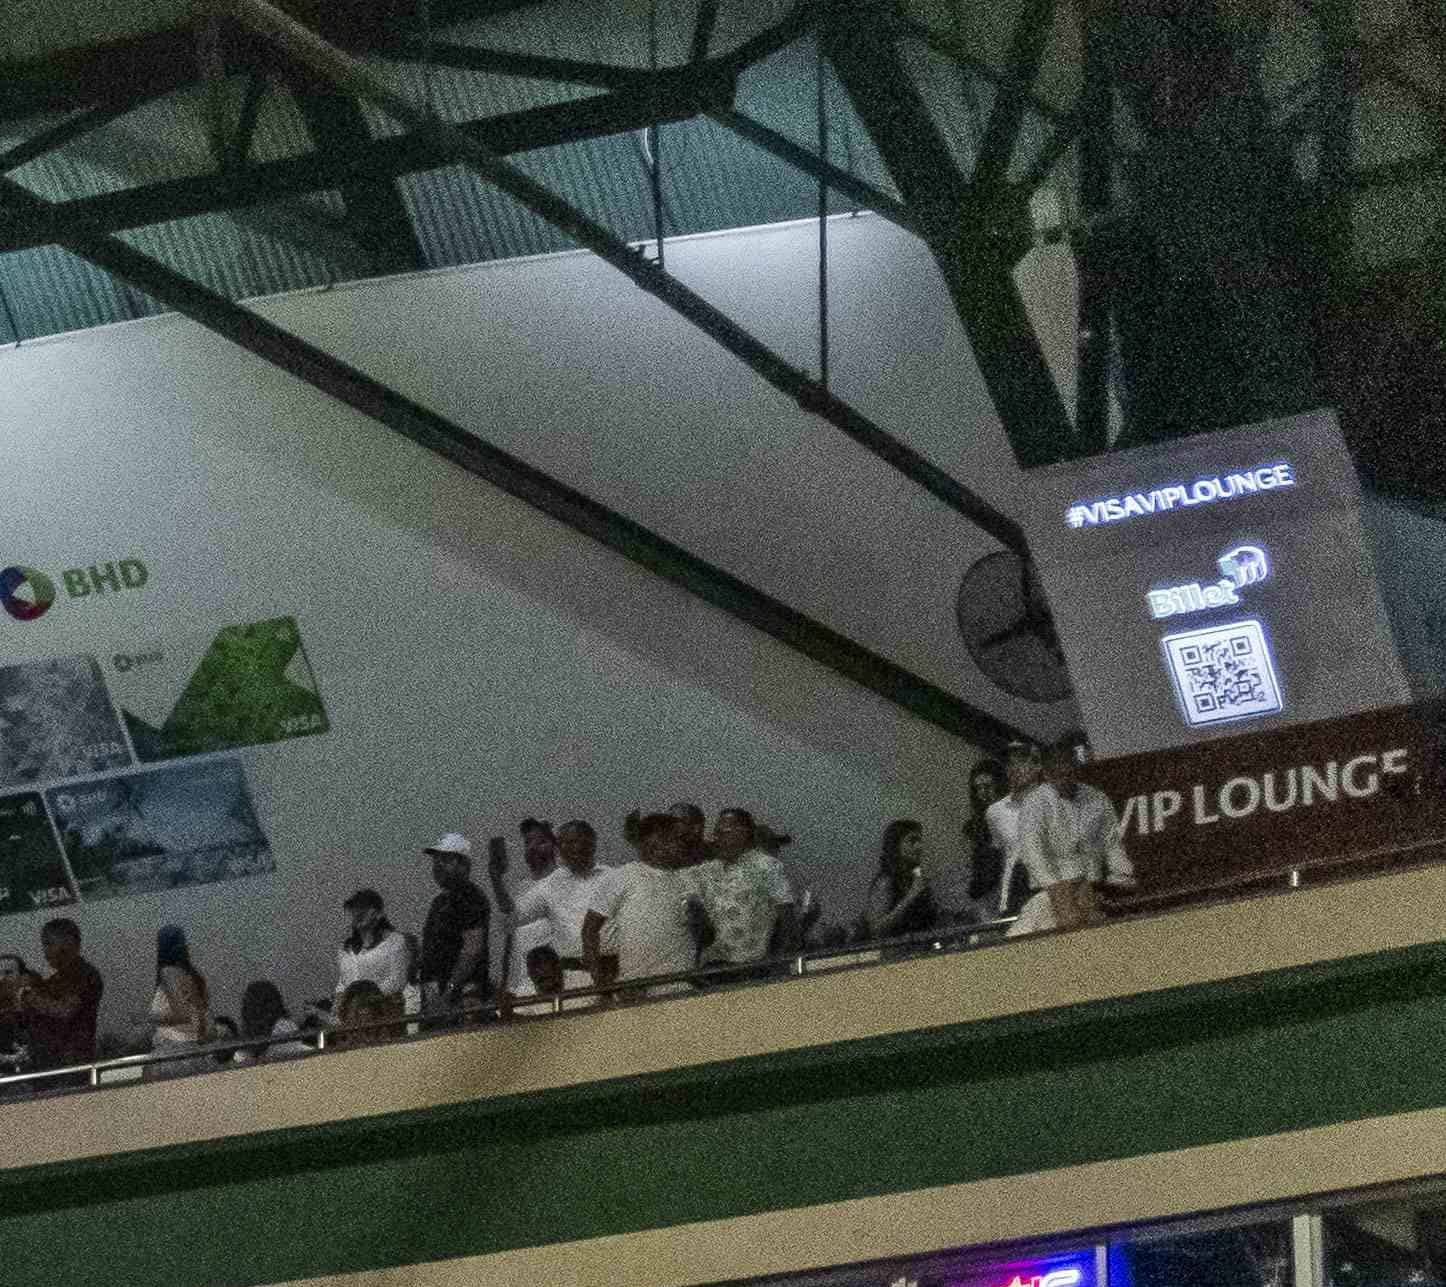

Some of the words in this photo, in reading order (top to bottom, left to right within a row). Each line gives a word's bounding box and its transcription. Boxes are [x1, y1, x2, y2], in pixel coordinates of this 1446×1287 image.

[1066, 461, 1295, 528] #VISAVIPLOUNGE
[63, 559, 149, 600] BHD
[1145, 579, 1239, 620] Billet
[28, 885, 72, 905] VISA
